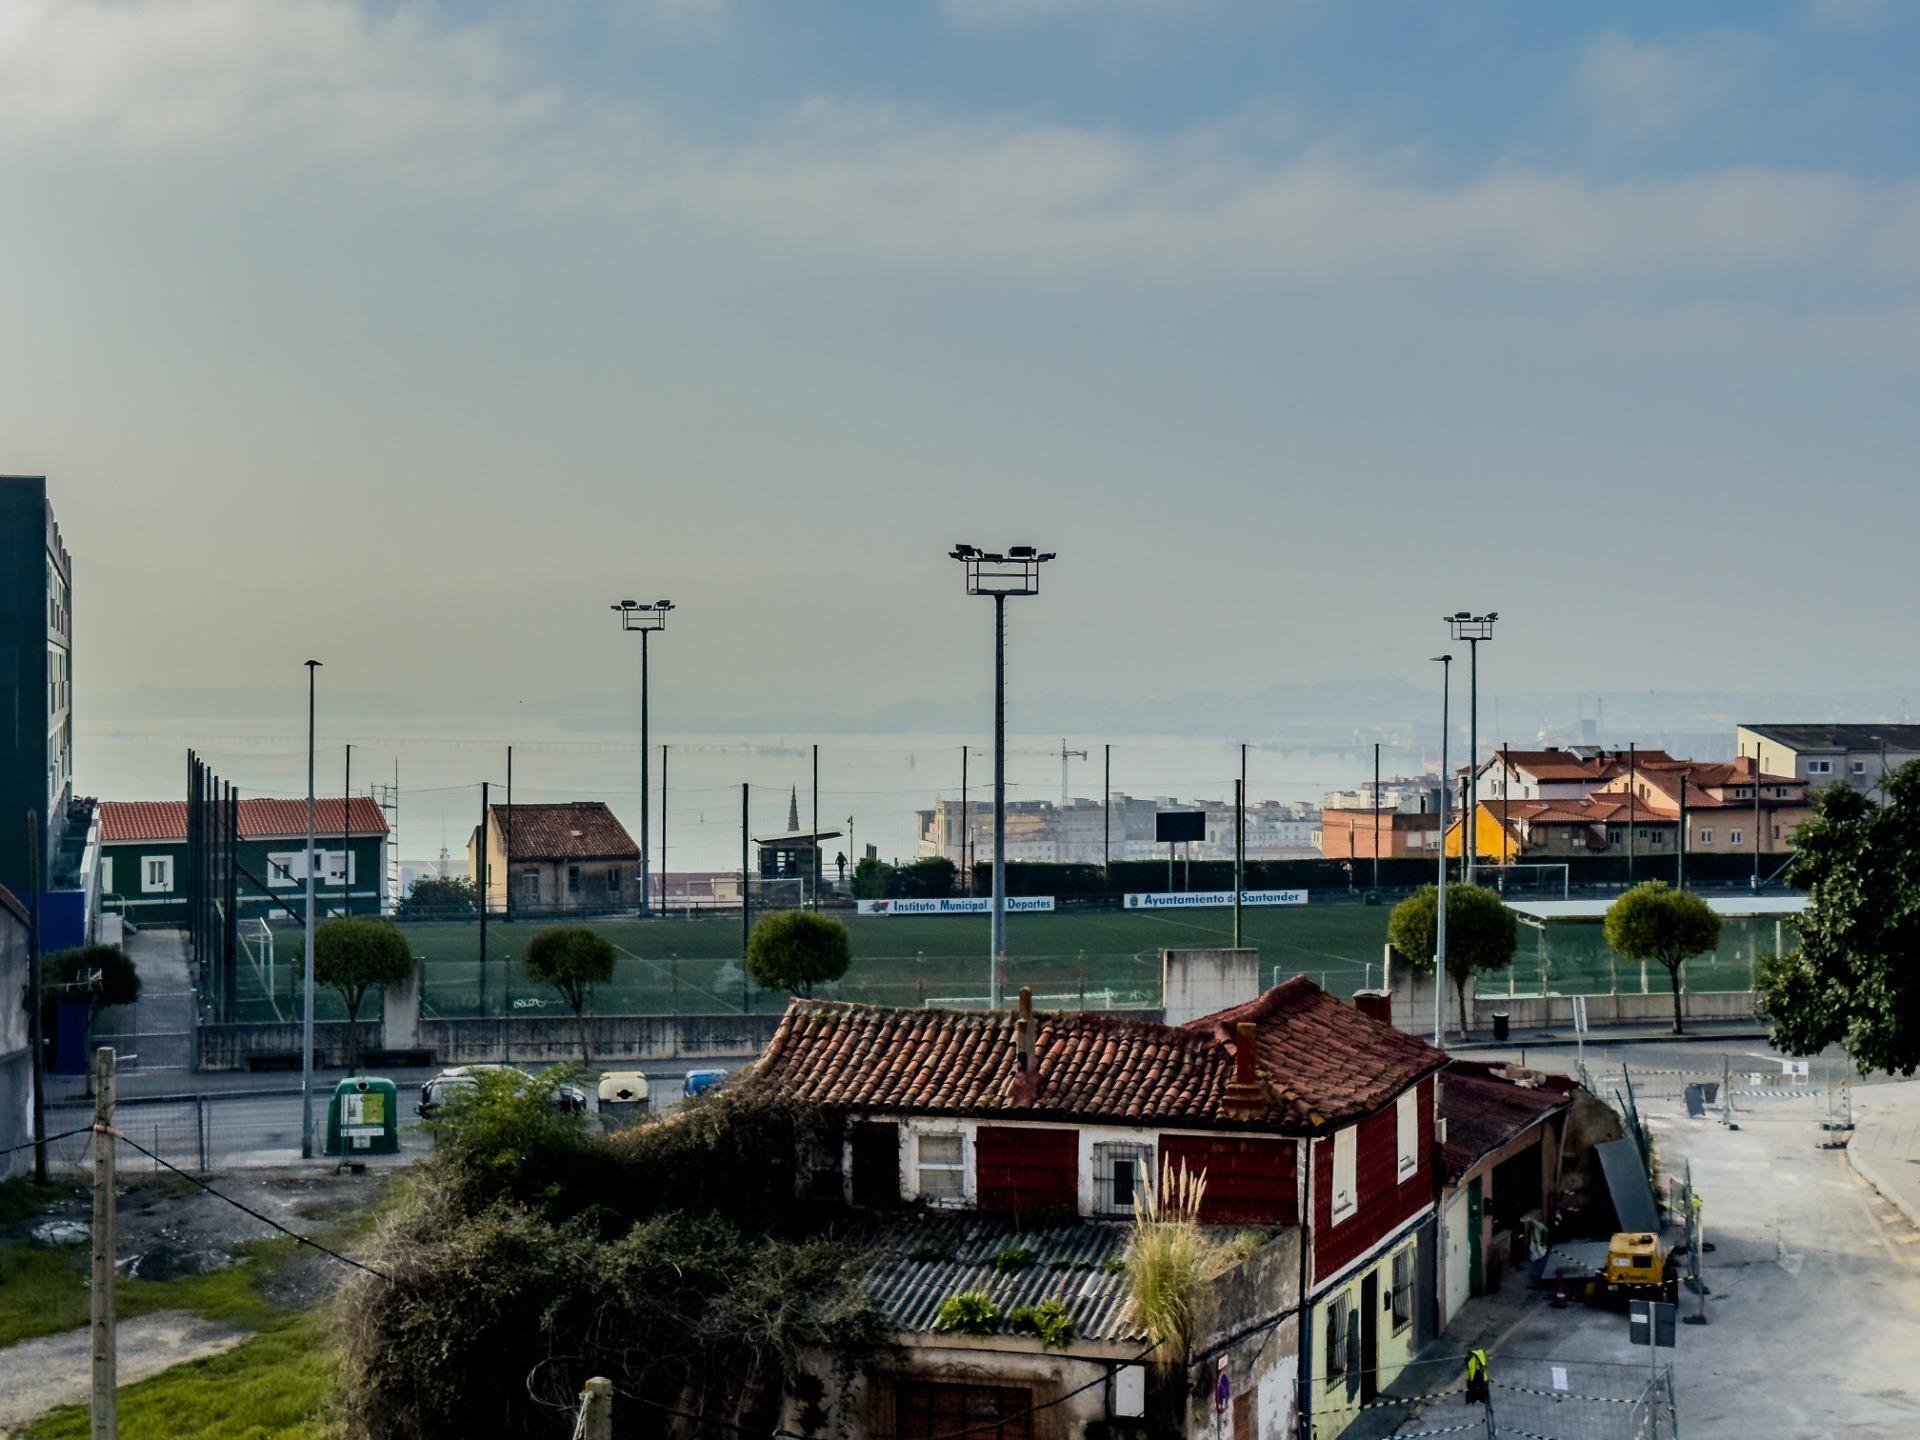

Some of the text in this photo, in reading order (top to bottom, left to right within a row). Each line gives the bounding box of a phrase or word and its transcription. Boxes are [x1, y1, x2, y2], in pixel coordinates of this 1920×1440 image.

[894, 897, 1051, 912] Instituto Municipal Deportes
[1144, 894, 1225, 907] Ayuntamiento
[1241, 891, 1299, 903] Santander
